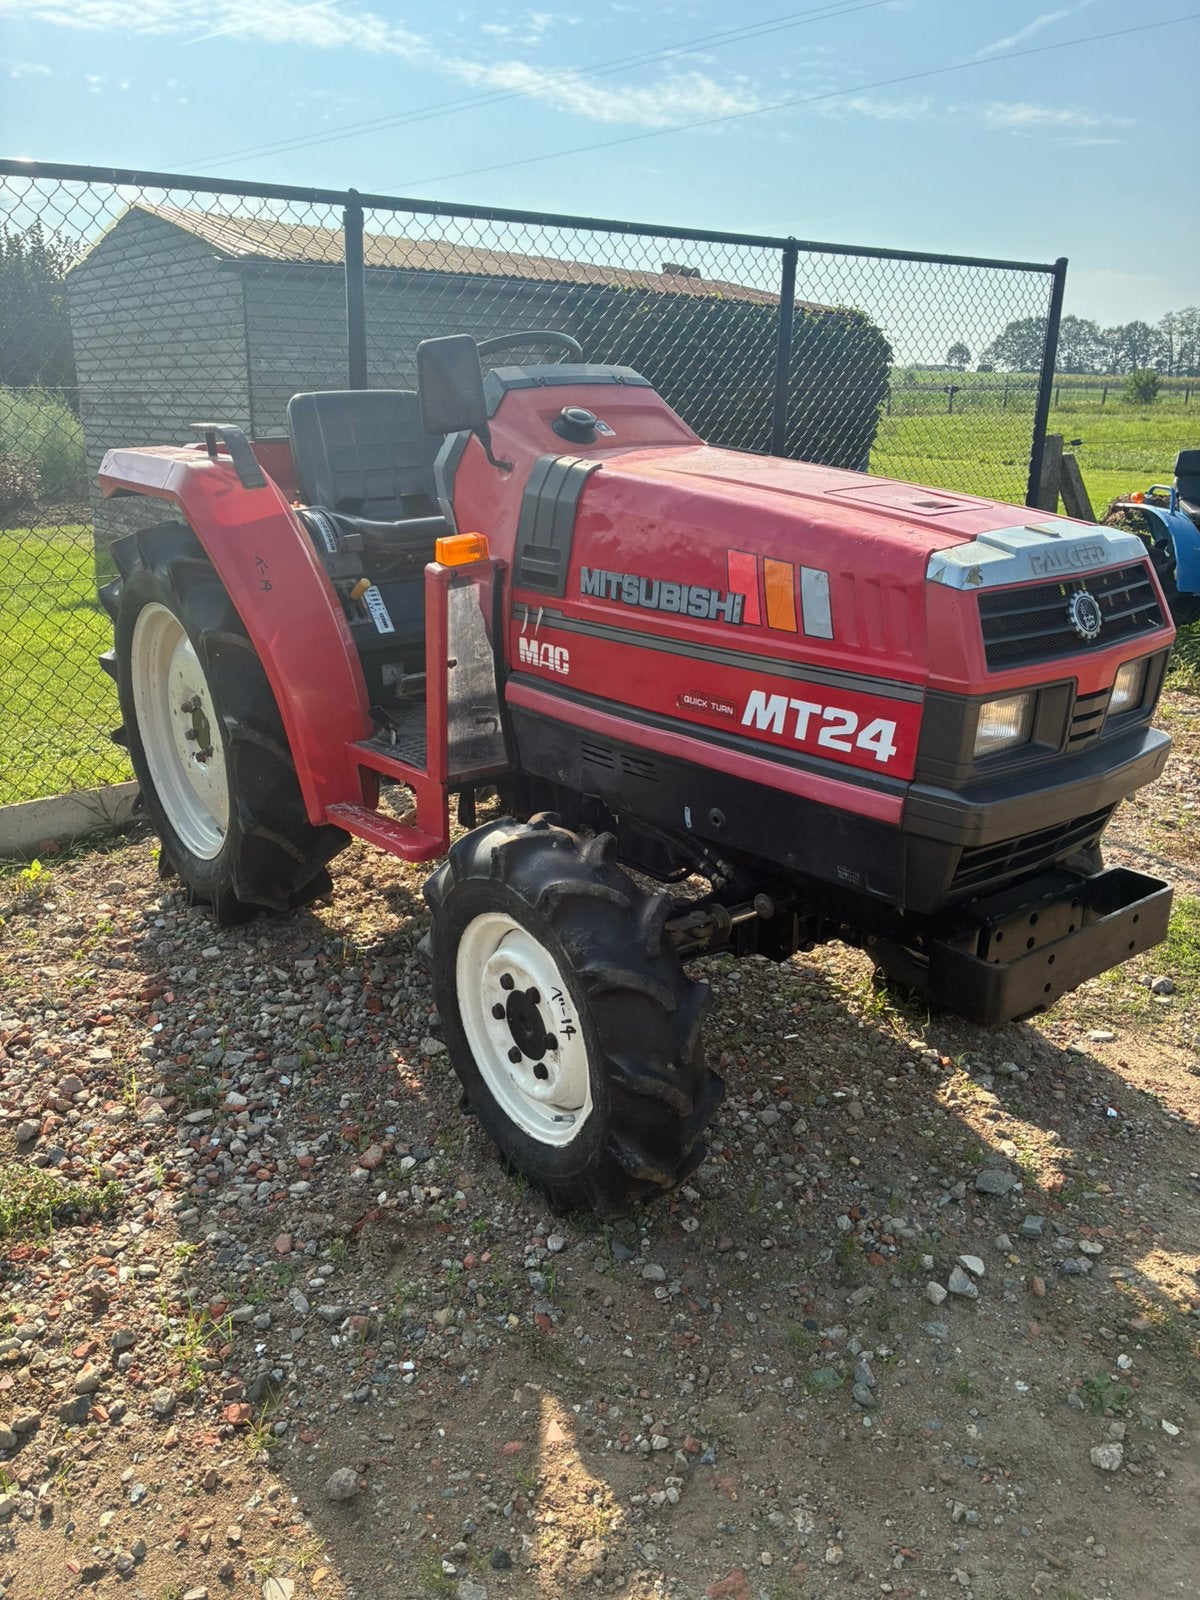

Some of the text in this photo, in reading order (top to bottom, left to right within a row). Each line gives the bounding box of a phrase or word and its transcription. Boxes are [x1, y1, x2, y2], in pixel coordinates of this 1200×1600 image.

[580, 566, 745, 625] MITSUBISHI
[518, 637, 570, 675] MAC
[683, 695, 734, 715] QUICK TURN
[741, 689, 897, 763] MT24
